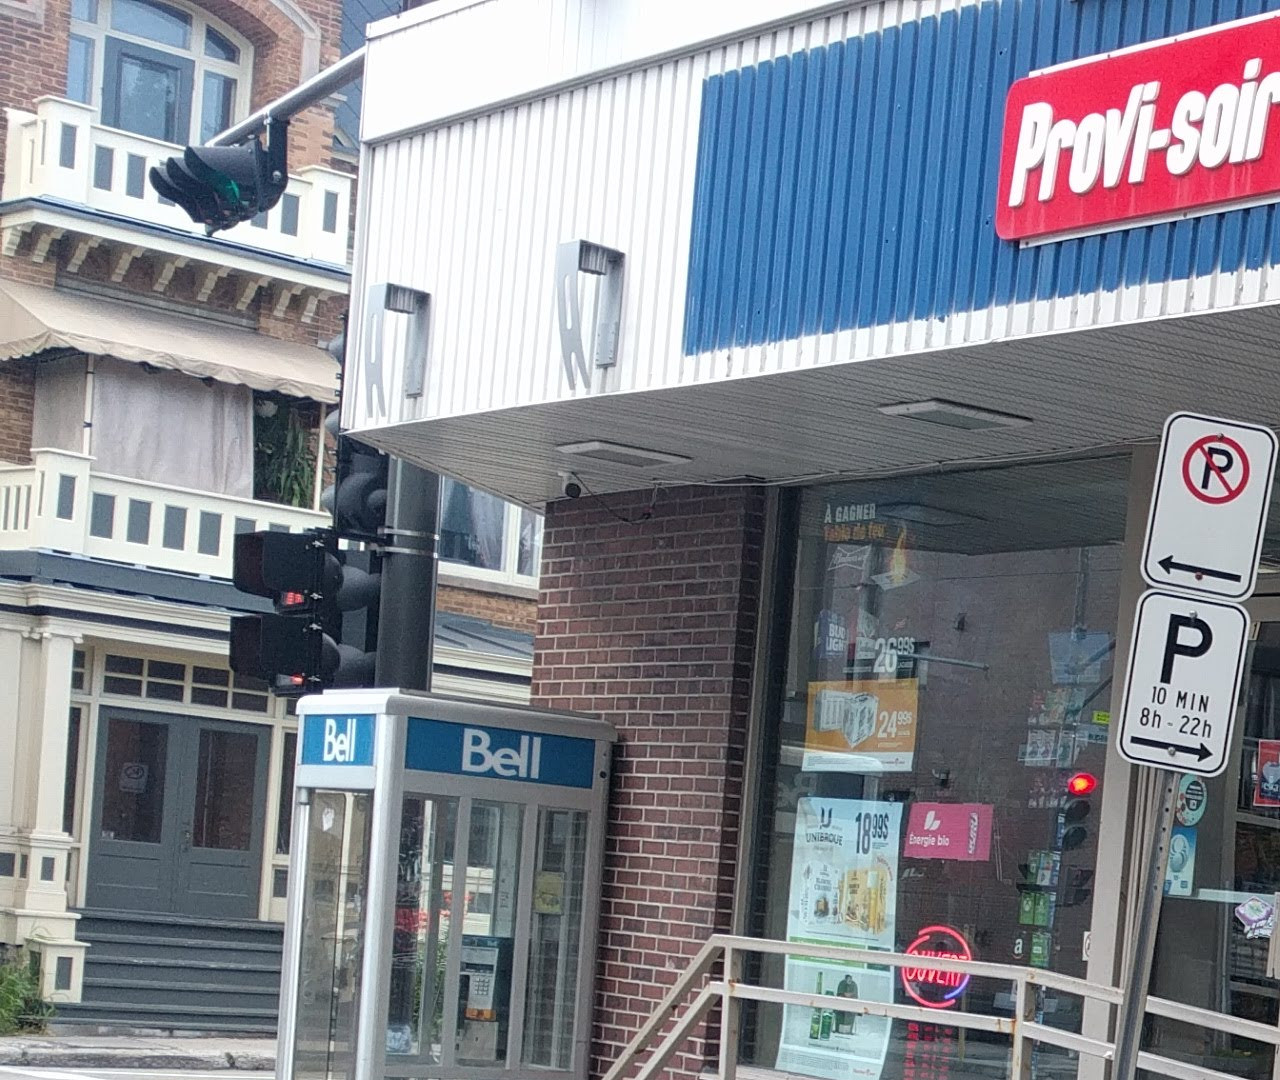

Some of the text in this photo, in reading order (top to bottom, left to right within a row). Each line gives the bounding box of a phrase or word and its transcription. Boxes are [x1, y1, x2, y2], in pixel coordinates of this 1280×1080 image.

[835, 503, 876, 522] GAGNER
[829, 623, 846, 640] BUD
[1160, 614, 1213, 684] P
[1152, 686, 1210, 713] 10 MIN
[1139, 707, 1162, 729] 8h
[1179, 715, 1212, 739] 22h
[322, 718, 357, 762] Bell
[461, 727, 542, 779] Bell
[909, 831, 950, 848] Énergie bio
